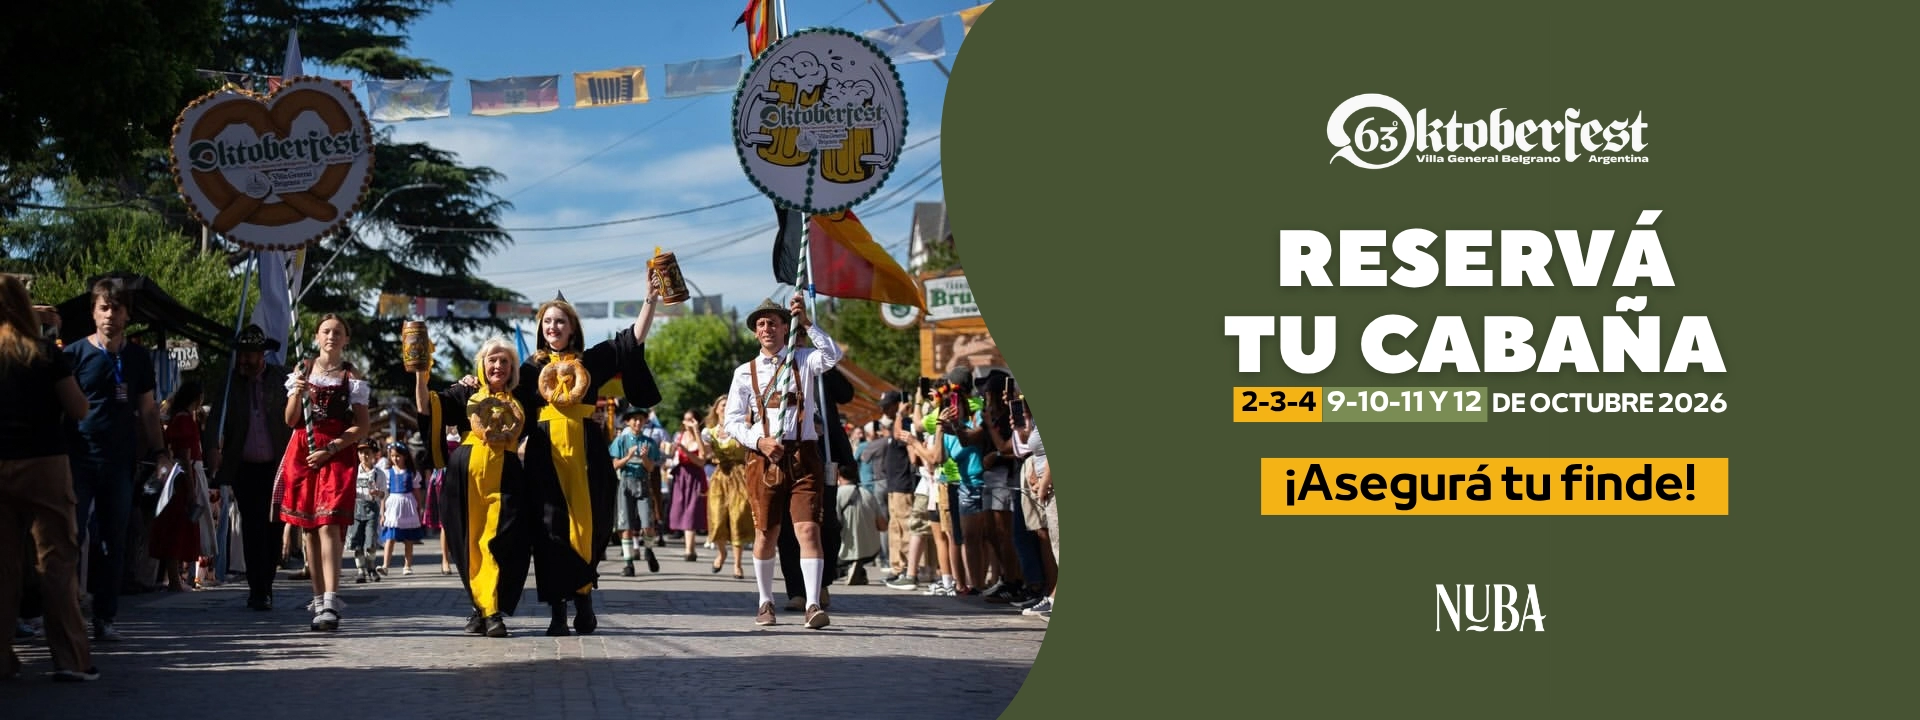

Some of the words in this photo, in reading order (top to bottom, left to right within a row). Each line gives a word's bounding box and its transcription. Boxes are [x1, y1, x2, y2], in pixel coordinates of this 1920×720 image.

[760, 102, 884, 127] Oktoberfest
[189, 129, 361, 169] Oktoberfest
[930, 288, 975, 307] Bru
